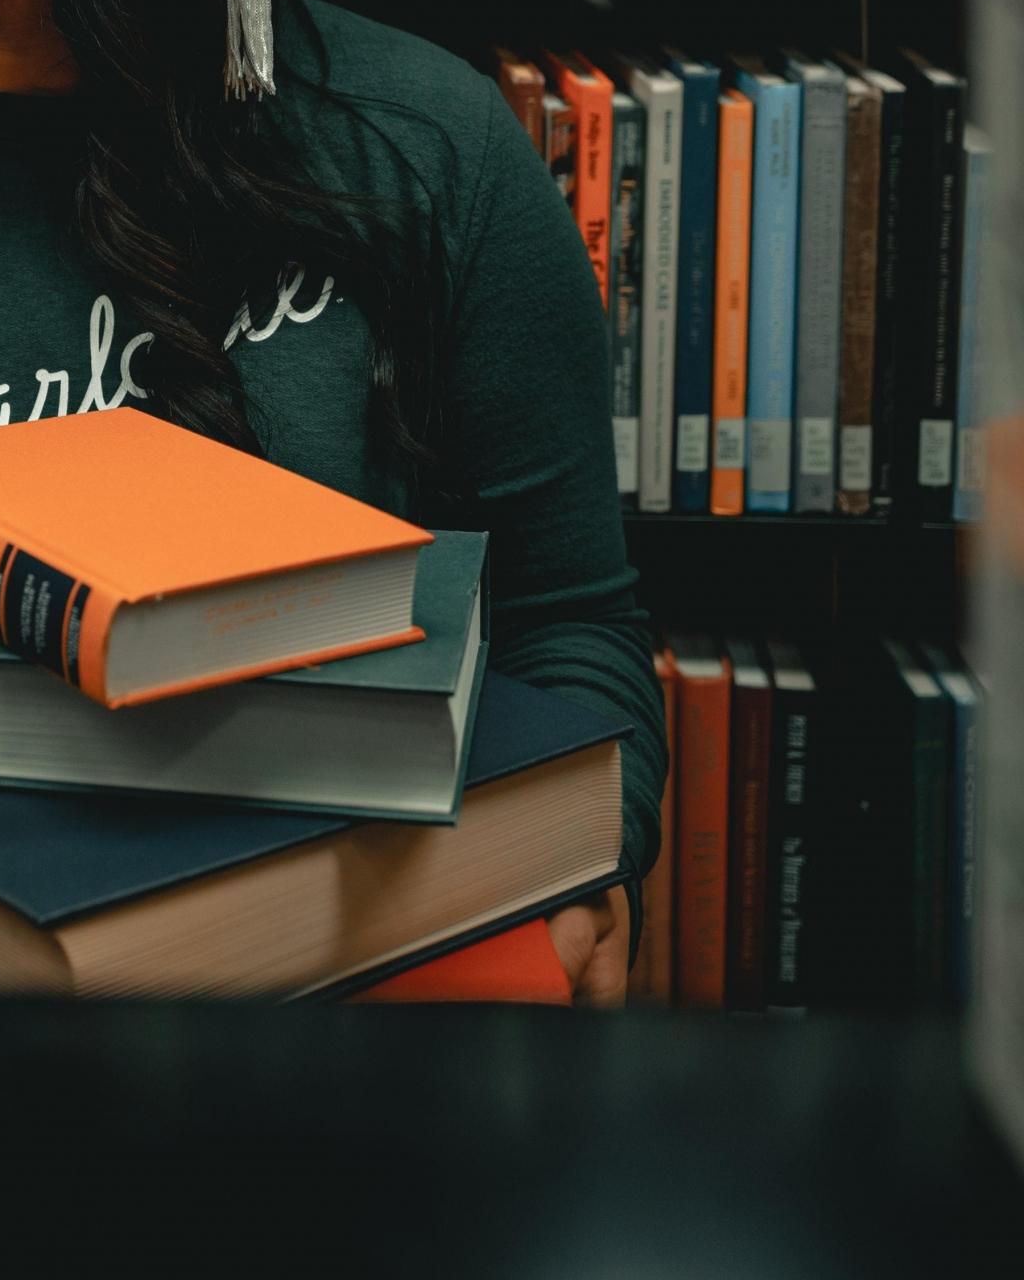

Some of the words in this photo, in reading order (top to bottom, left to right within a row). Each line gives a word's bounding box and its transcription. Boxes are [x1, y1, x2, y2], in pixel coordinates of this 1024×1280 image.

[586, 219, 607, 253] The
[656, 178, 674, 268] EMBODIED
[655, 272, 672, 312] CARE
